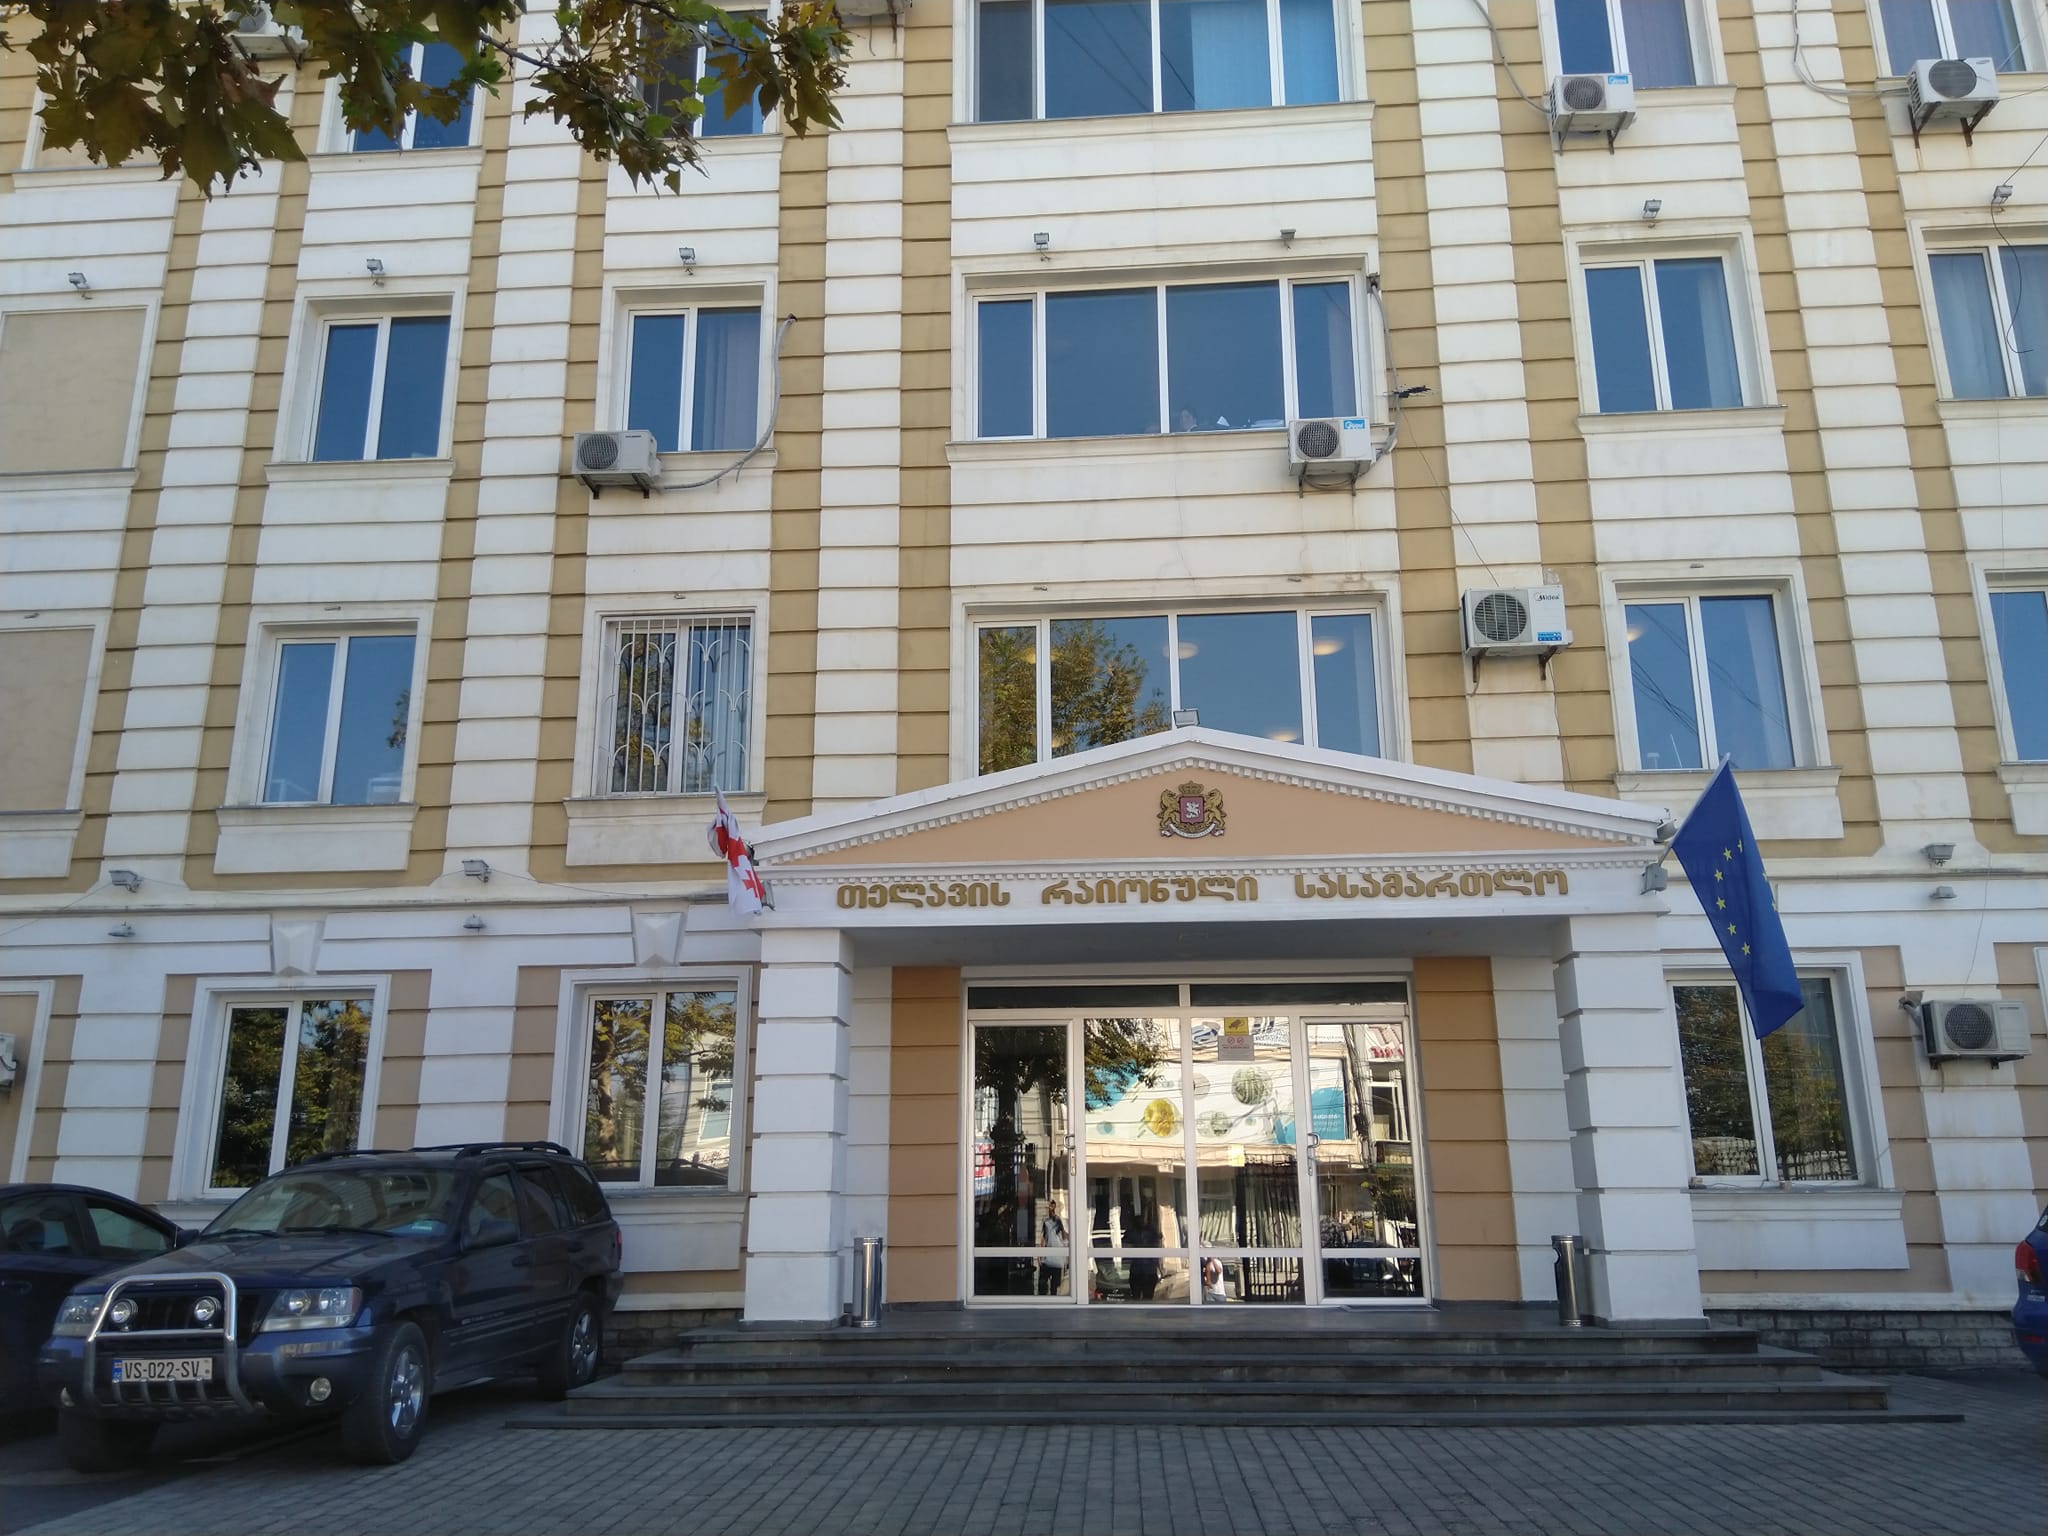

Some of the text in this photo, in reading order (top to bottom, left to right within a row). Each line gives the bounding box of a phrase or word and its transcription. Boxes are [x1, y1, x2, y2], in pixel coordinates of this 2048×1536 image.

[837, 870, 1568, 908] თელავის რაიონული სასამართლო
[125, 1361, 199, 1379] VS-022-SV
